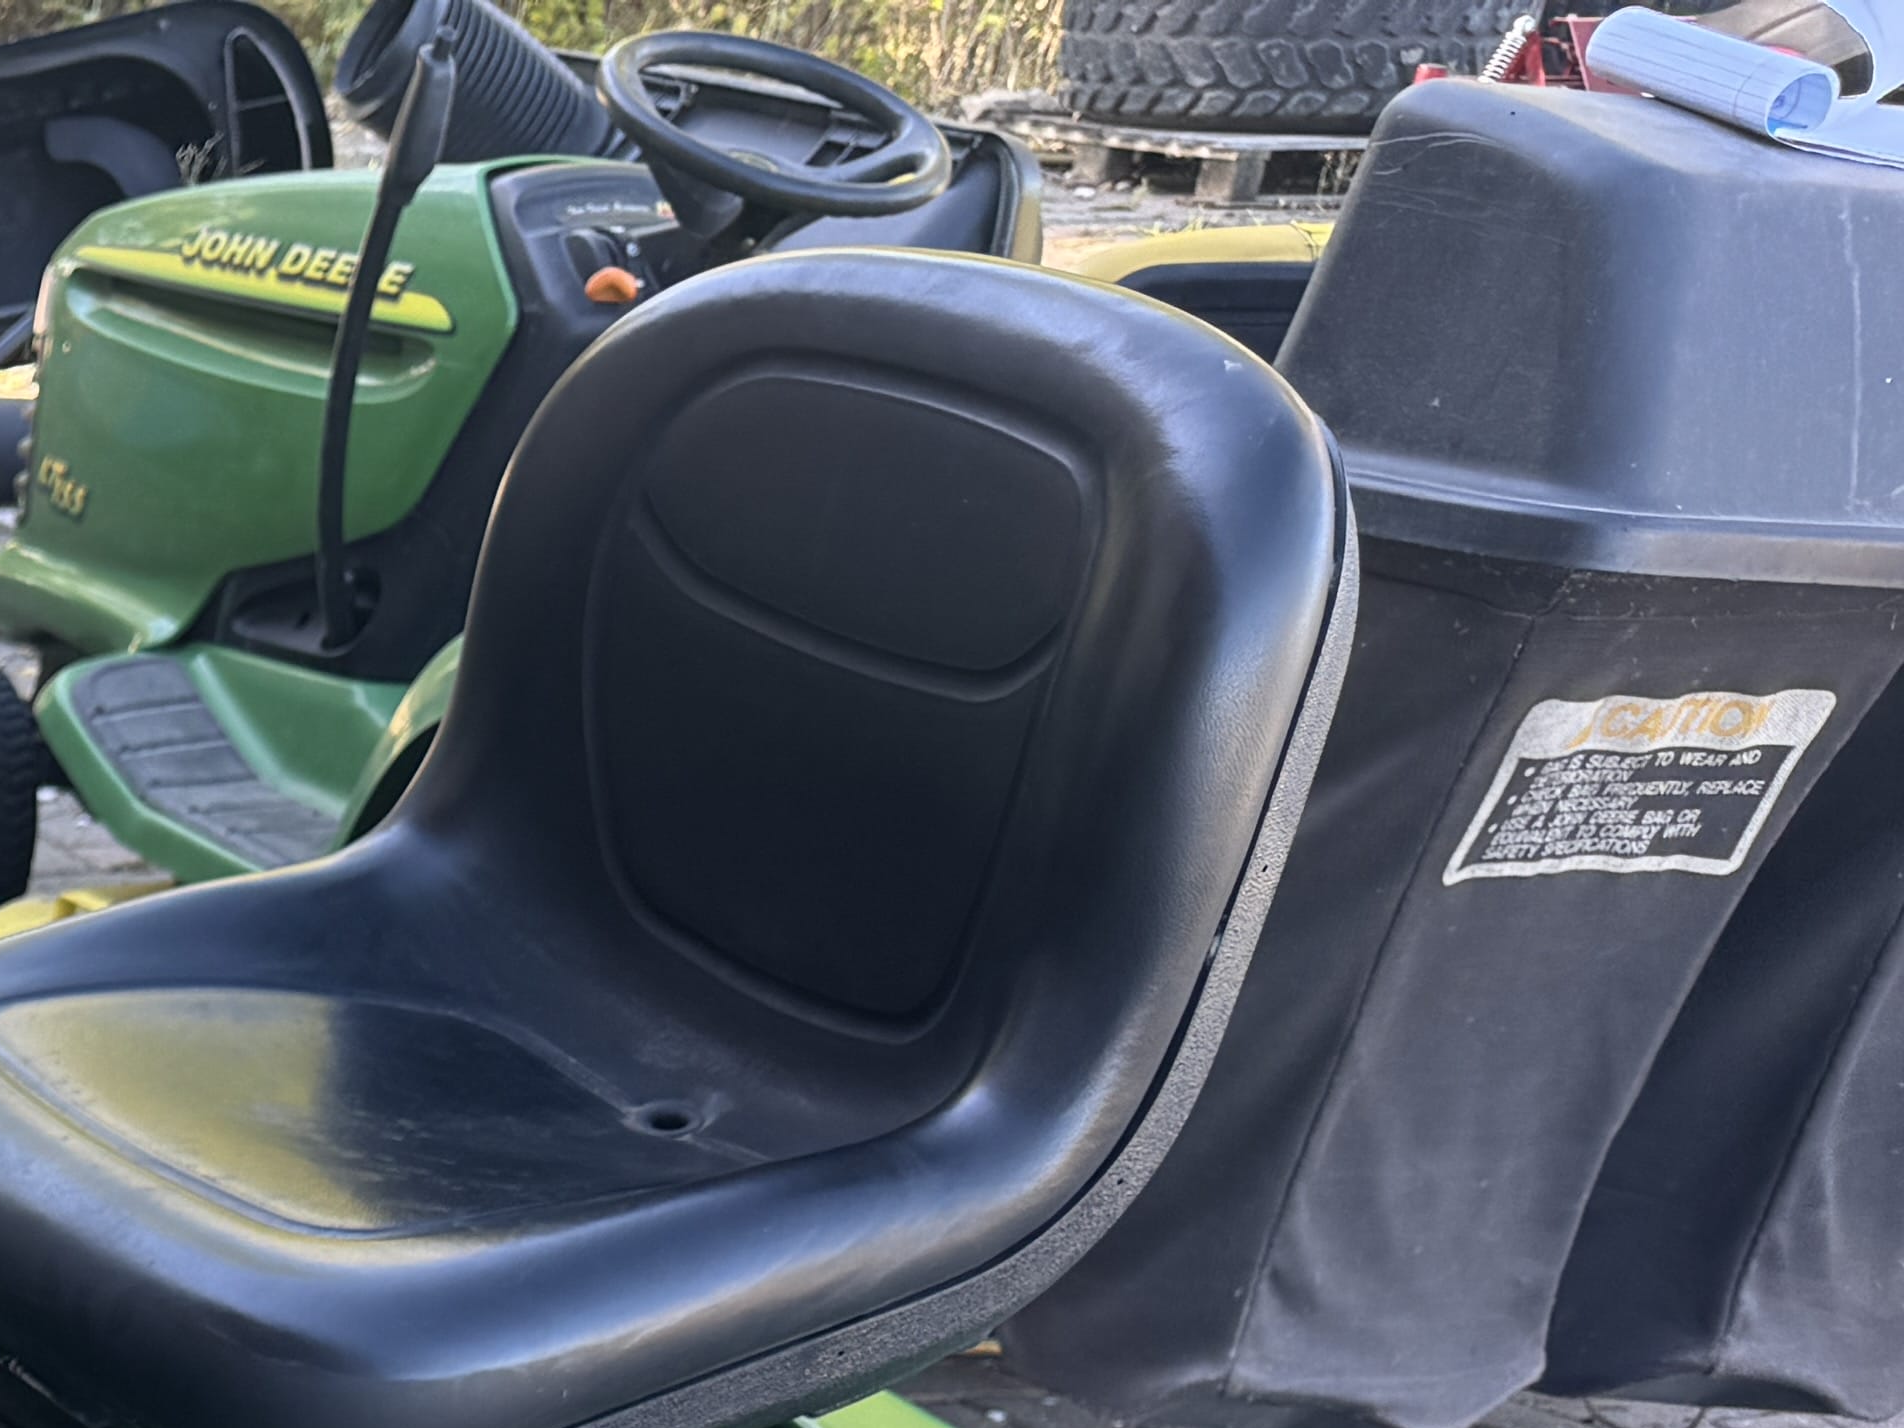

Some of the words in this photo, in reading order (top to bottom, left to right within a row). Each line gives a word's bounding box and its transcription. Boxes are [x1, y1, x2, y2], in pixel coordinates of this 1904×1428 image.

[179, 227, 277, 272] JOHN
[278, 242, 414, 298] DEEE
[1583, 754, 1653, 771] SUBJECT
[1651, 753, 1676, 769] TO
[1675, 751, 1730, 768] WEAR
[1728, 750, 1764, 766] AND
[1694, 779, 1767, 797] REPLACE
[1553, 797, 1639, 814] NECESSARY
[1546, 814, 1587, 828] JOHN
[1586, 812, 1639, 826] DEERE
[1639, 810, 1675, 824] BAG
[1572, 828, 1596, 842] TO
[1595, 825, 1661, 841] COMPLY
[1660, 823, 1702, 838] WITH
[1481, 844, 1539, 860] SAFETY
[1539, 839, 1652, 858] SPECIFICATIONS
